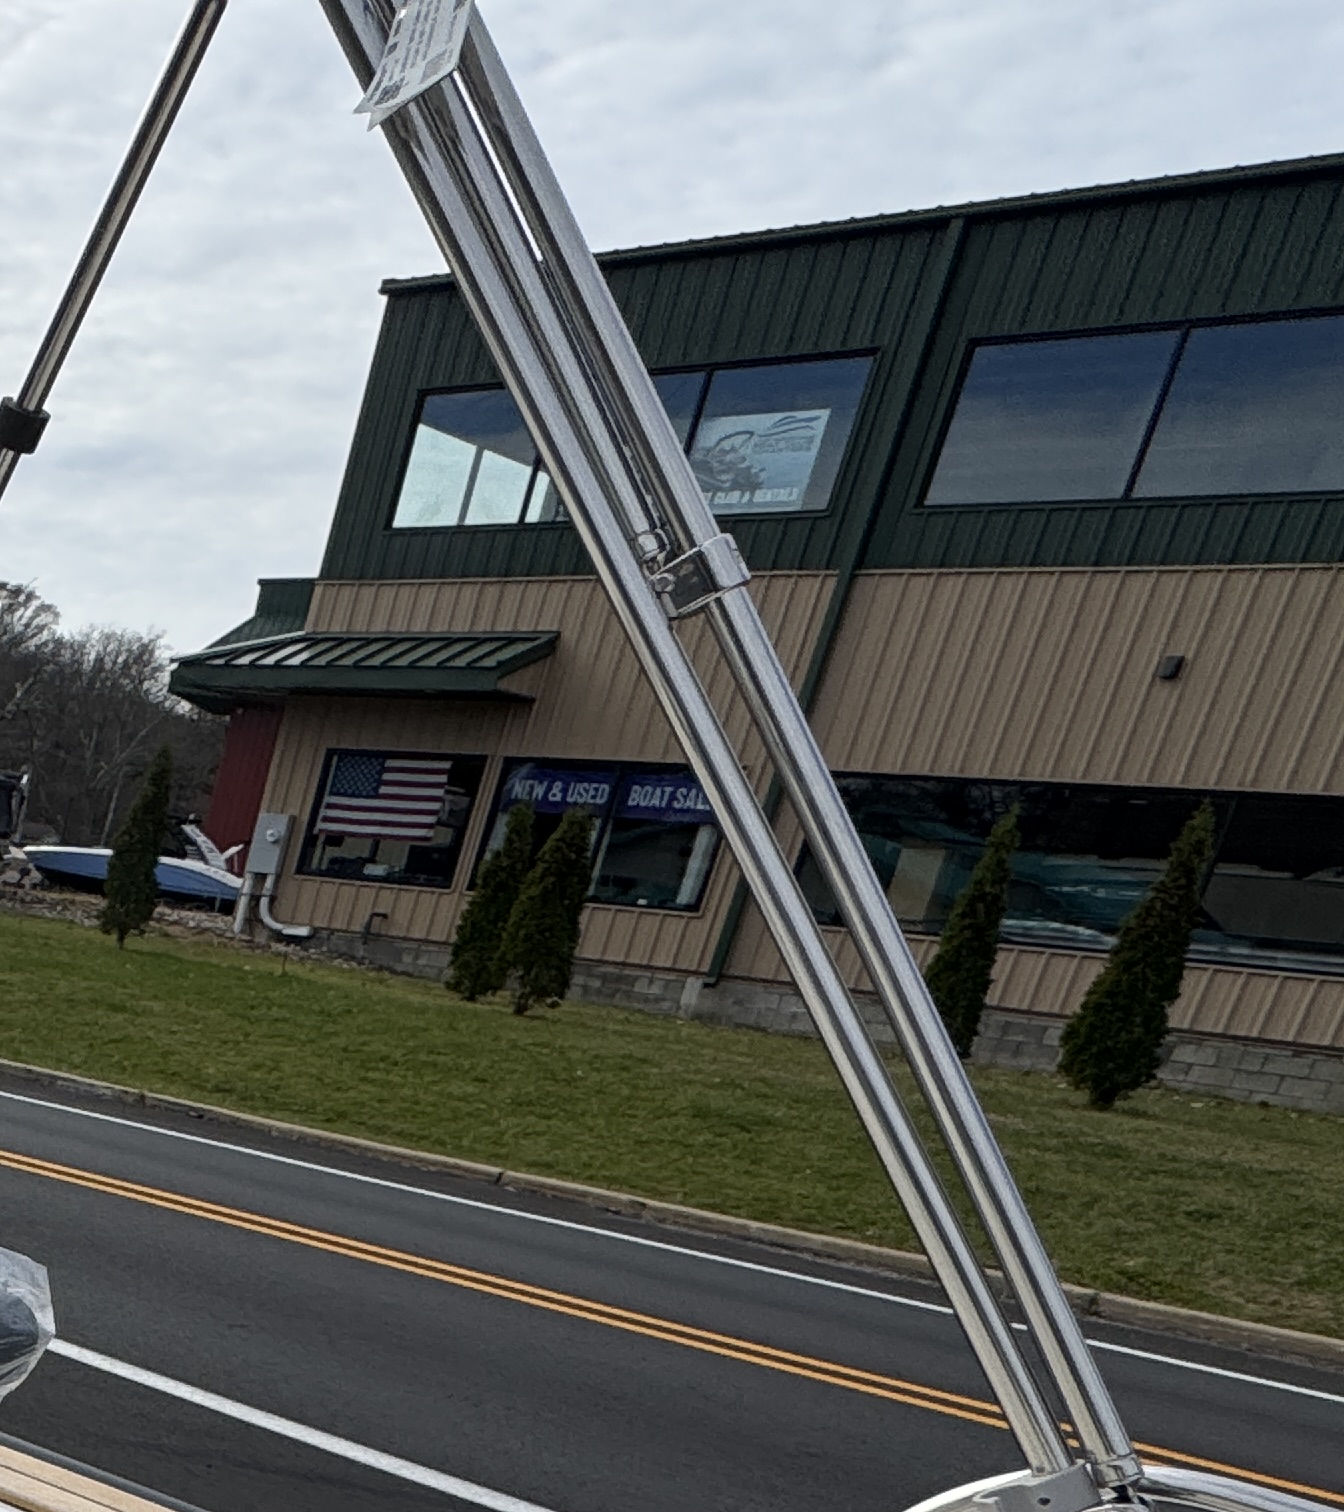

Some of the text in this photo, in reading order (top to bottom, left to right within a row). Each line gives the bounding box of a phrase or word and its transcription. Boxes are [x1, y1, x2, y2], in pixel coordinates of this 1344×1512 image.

[512, 778, 712, 812] NEW & USED BOAT SAL
